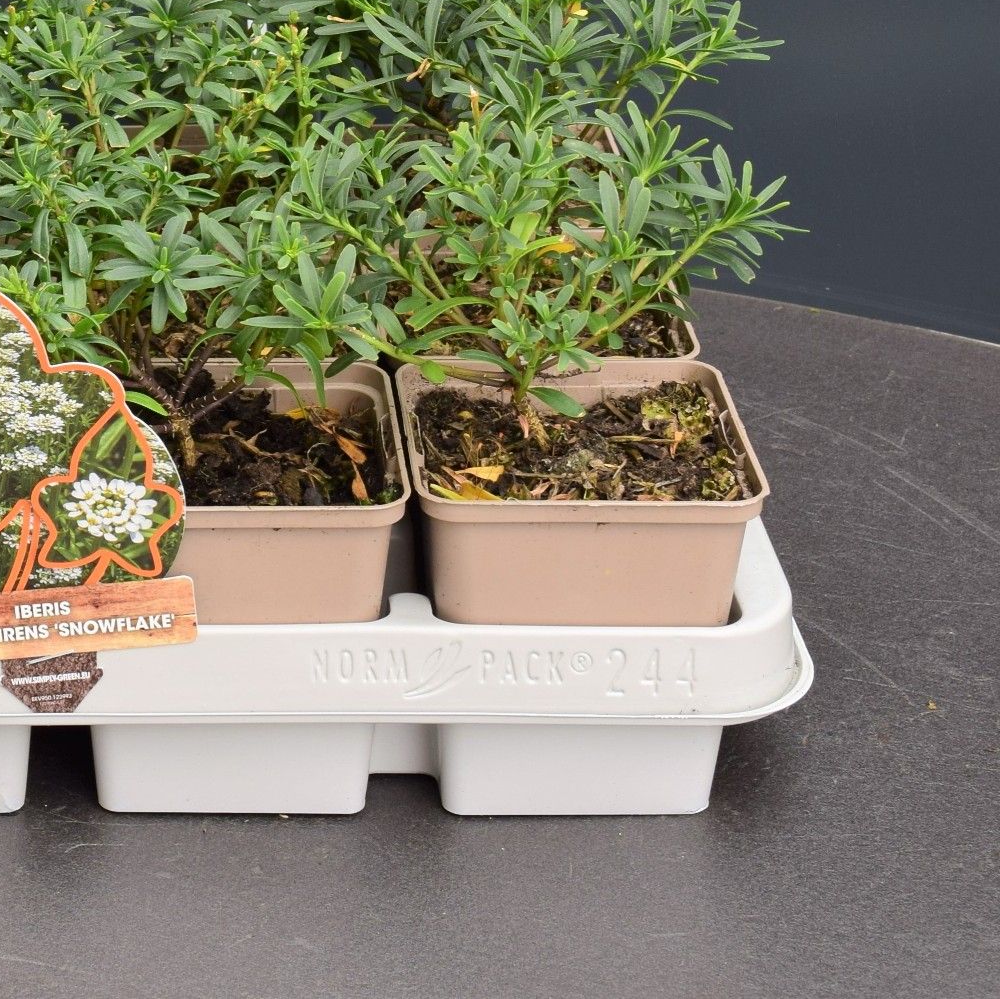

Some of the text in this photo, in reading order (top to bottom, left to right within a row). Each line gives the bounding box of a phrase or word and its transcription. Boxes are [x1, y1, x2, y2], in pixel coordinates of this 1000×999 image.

[14, 601, 71, 620] IBERIS
[54, 614, 175, 637] 'SNOWFLAKE'
[11, 671, 91, 686] WWW.SIMPLY-GREEN.EU
[310, 647, 409, 684] NORM
[605, 647, 699, 697] 244
